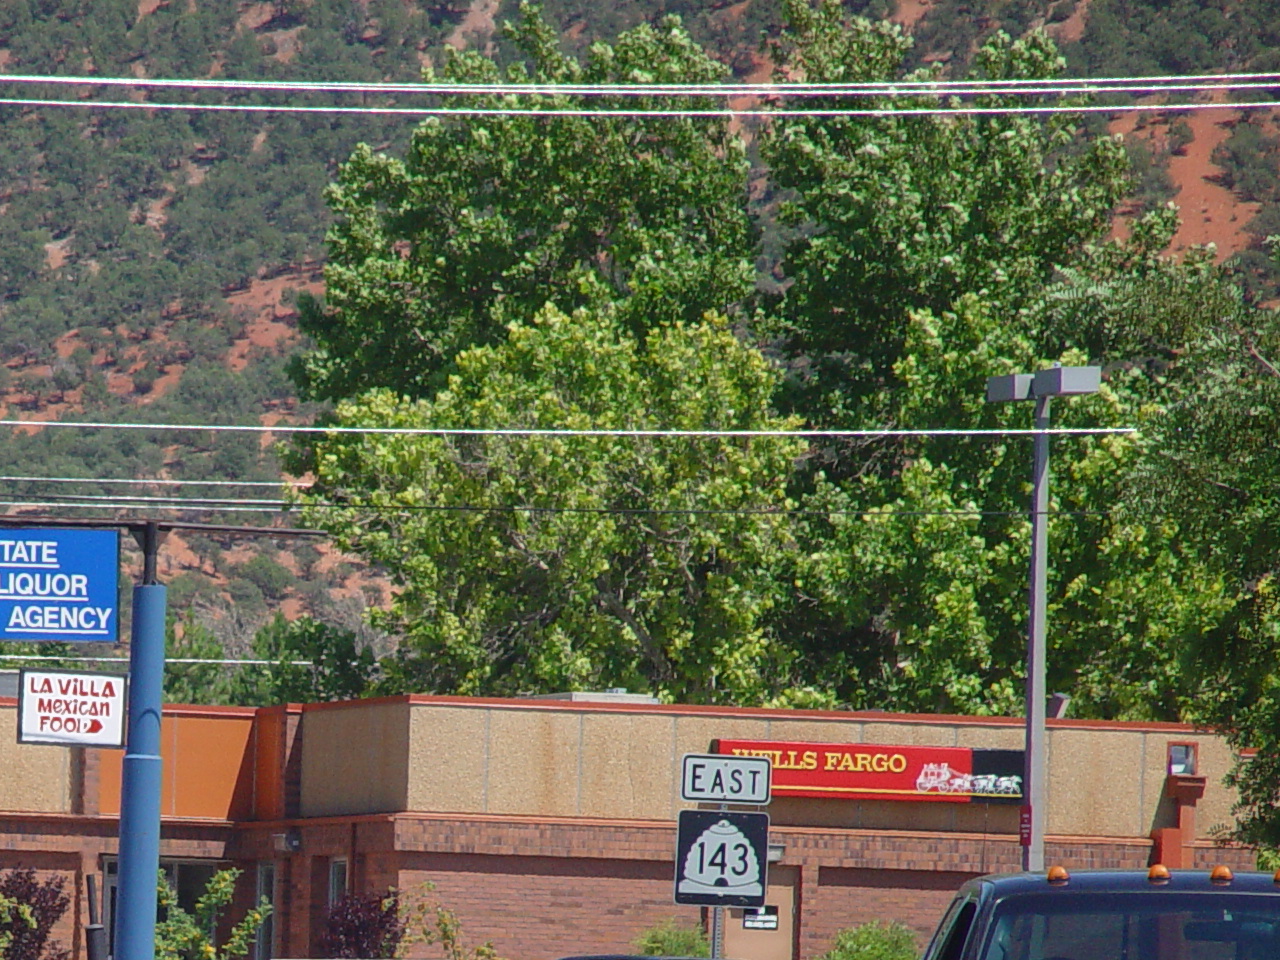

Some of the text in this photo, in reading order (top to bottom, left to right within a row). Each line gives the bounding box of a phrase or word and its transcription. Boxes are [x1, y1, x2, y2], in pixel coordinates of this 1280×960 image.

[8, 606, 113, 629] AGENCY
[30, 677, 53, 694] LA
[824, 752, 907, 773] FARGO
[691, 763, 761, 796] EAST
[698, 841, 749, 876] 143
